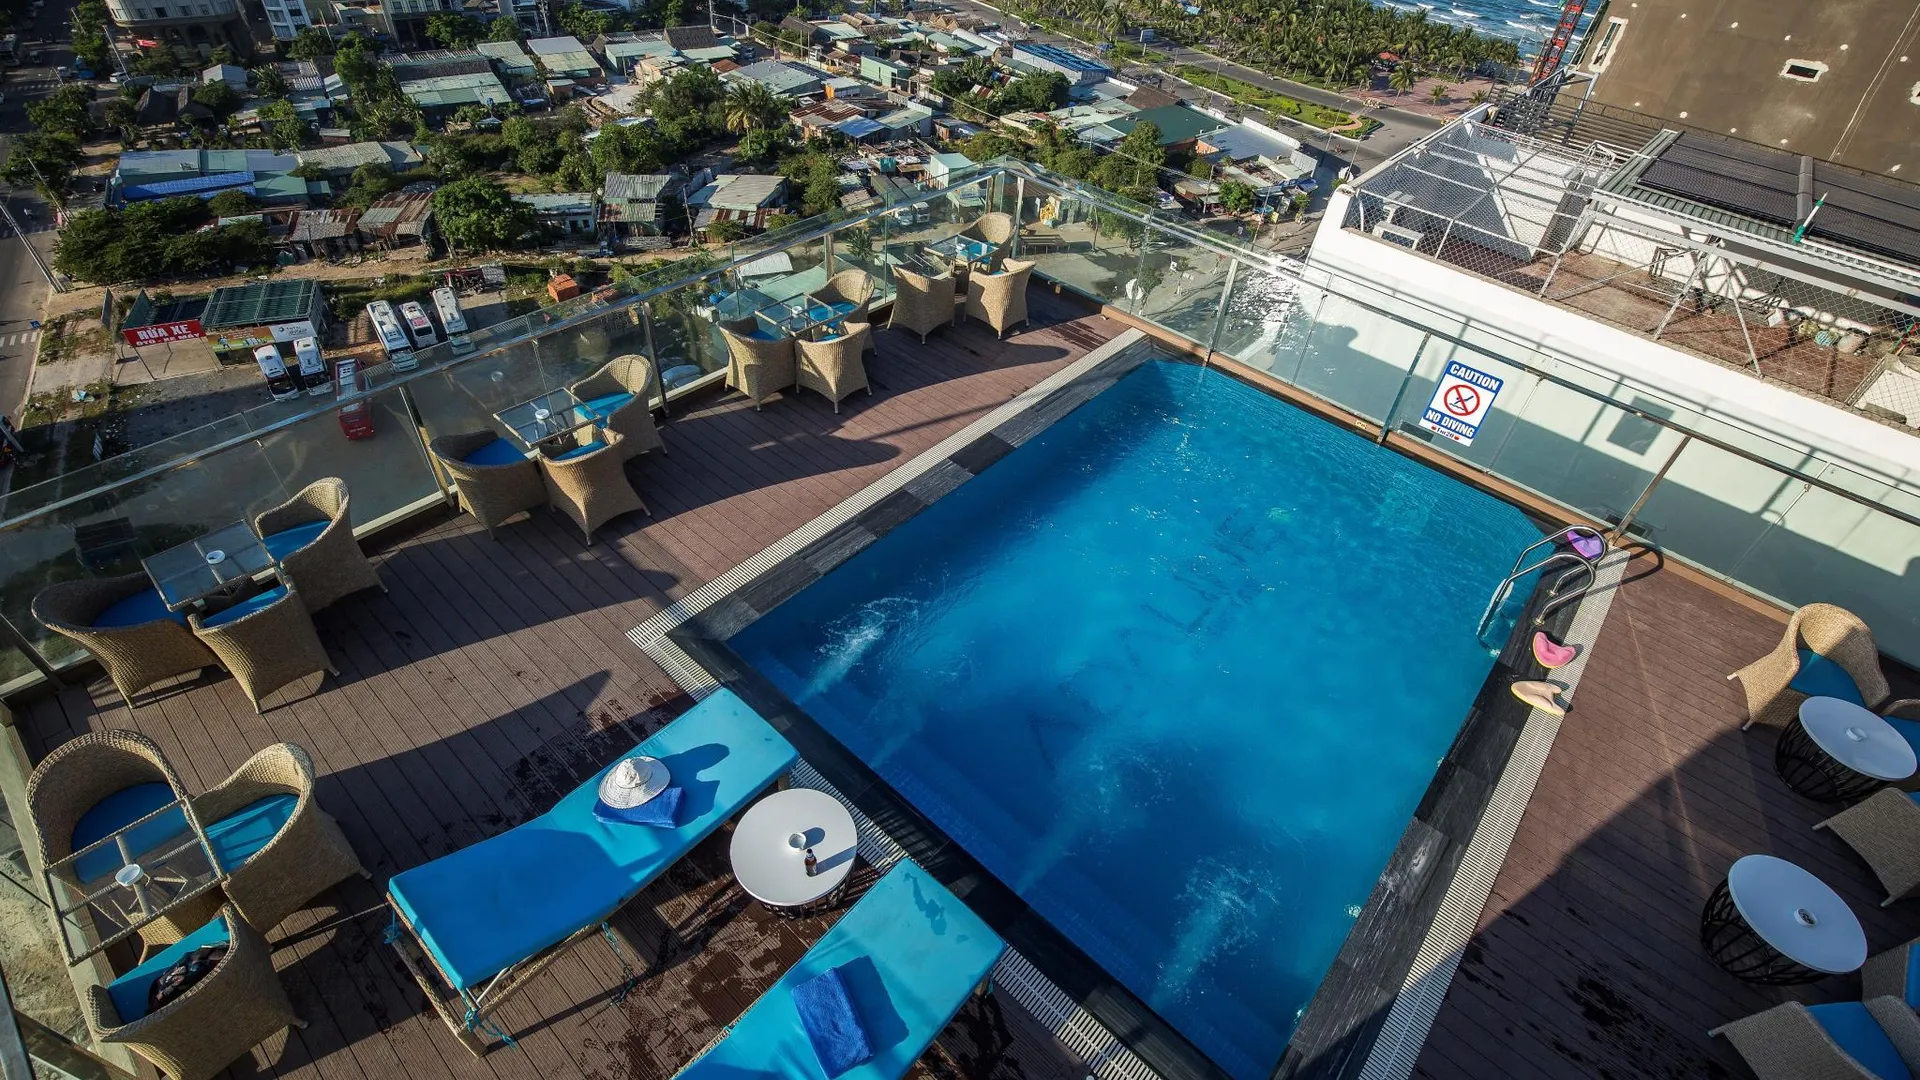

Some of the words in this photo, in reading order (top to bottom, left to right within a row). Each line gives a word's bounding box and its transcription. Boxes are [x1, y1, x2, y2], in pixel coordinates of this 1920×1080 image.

[171, 324, 192, 335] XE
[1449, 364, 1500, 391] CAUTION
[1425, 410, 1442, 422] NO
[1441, 417, 1475, 438] DIVING
